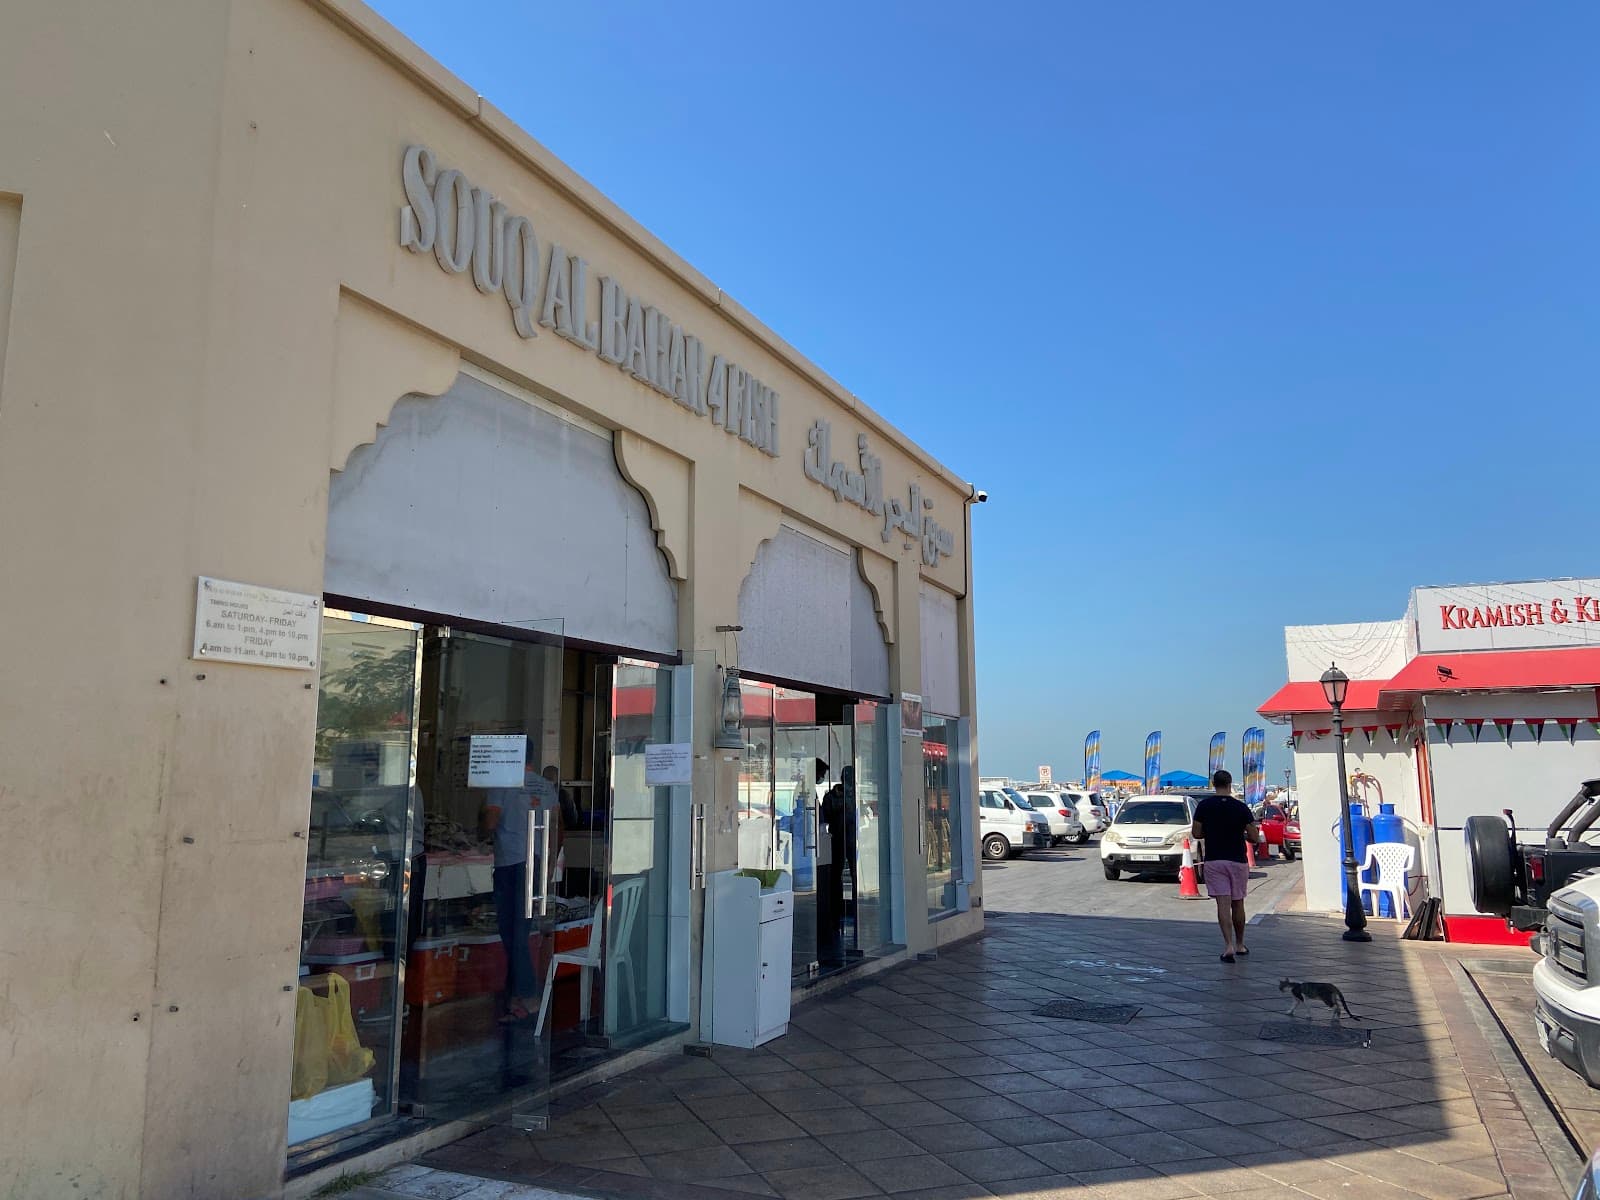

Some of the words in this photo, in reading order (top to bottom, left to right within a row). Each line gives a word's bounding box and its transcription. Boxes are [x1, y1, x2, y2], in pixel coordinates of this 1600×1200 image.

[400, 144, 540, 338] SOUQ
[539, 243, 599, 352] AL
[707, 354, 724, 426] 4
[725, 363, 781, 458] FISH
[1440, 602, 1544, 630] KRAMISH
[1550, 598, 1573, 625] &
[269, 616, 297, 628] FRIDAY
[227, 623, 235, 631] to
[278, 629, 286, 638] to
[244, 635, 274, 647] FRIDAY
[223, 645, 232, 653] to
